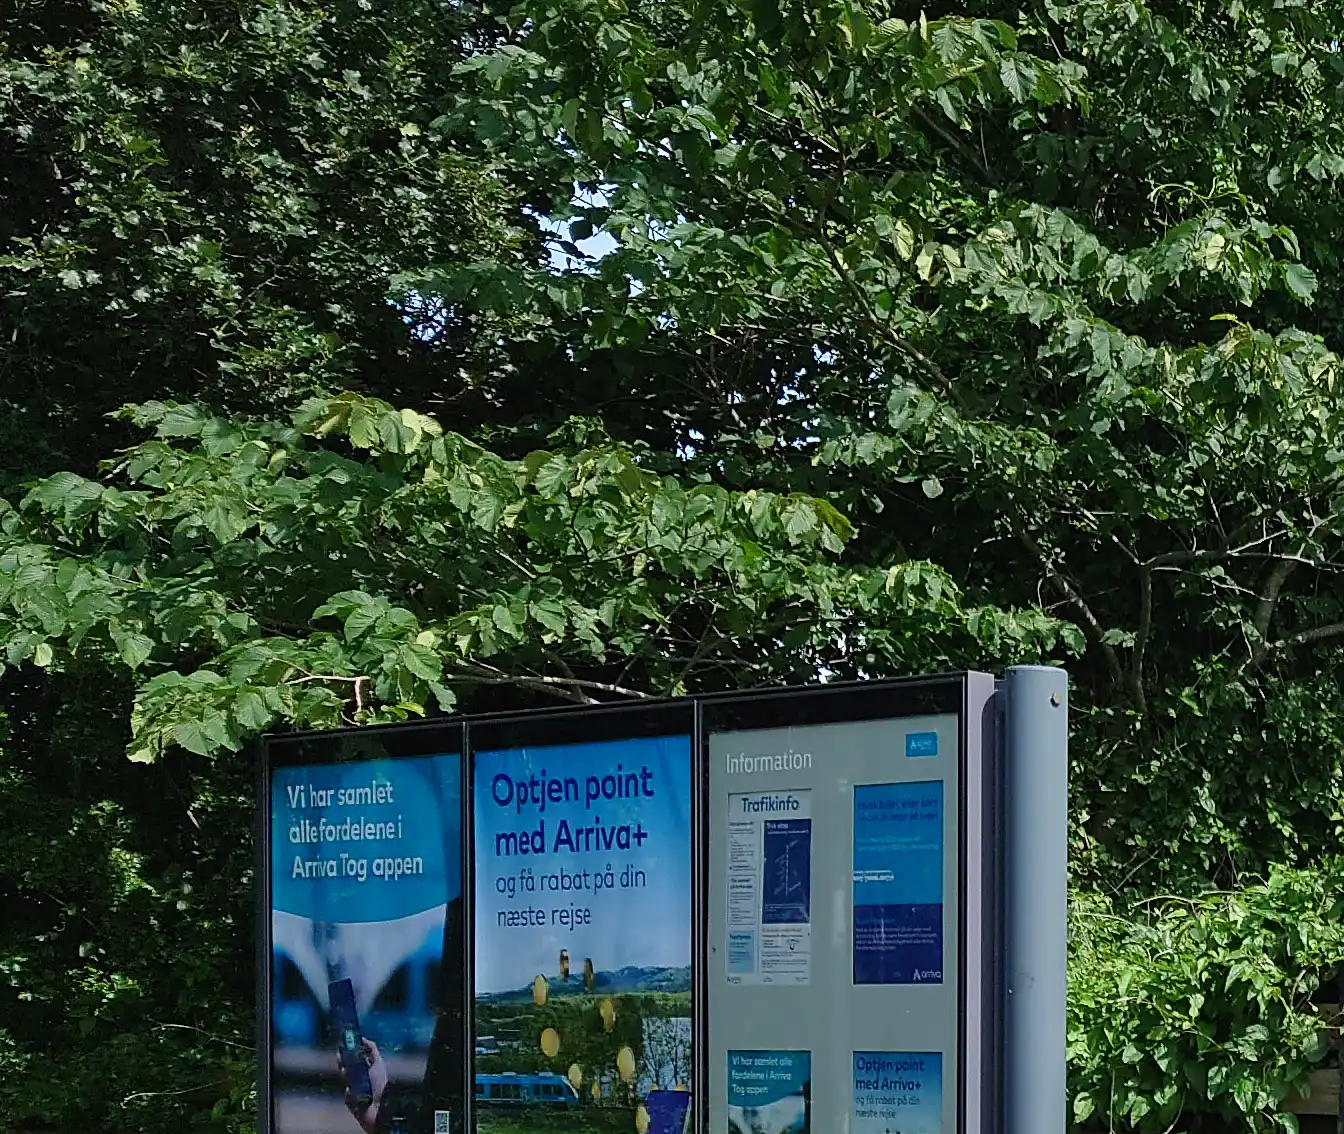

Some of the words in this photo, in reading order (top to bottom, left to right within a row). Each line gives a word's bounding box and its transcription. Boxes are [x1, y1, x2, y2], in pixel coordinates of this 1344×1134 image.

[726, 749, 812, 774] Information
[287, 784, 305, 808] Vi
[309, 783, 335, 808] har
[337, 780, 394, 806] samlet
[491, 768, 579, 814] Optjen
[585, 764, 655, 810] point
[741, 795, 799, 813] Trafikinfo
[289, 818, 318, 844] alle
[319, 816, 395, 842] fordelene
[398, 814, 402, 839] i
[495, 819, 546, 856] med
[553, 816, 648, 853] Arriva+
[292, 854, 337, 878] Arriva
[339, 853, 367, 882] Tog
[372, 855, 423, 881] appen
[496, 876, 516, 898] og
[520, 868, 535, 892] få
[540, 867, 591, 891] rabat
[594, 863, 614, 896] på
[620, 864, 646, 888] din
[497, 906, 546, 927] næste
[551, 902, 592, 931] rejse
